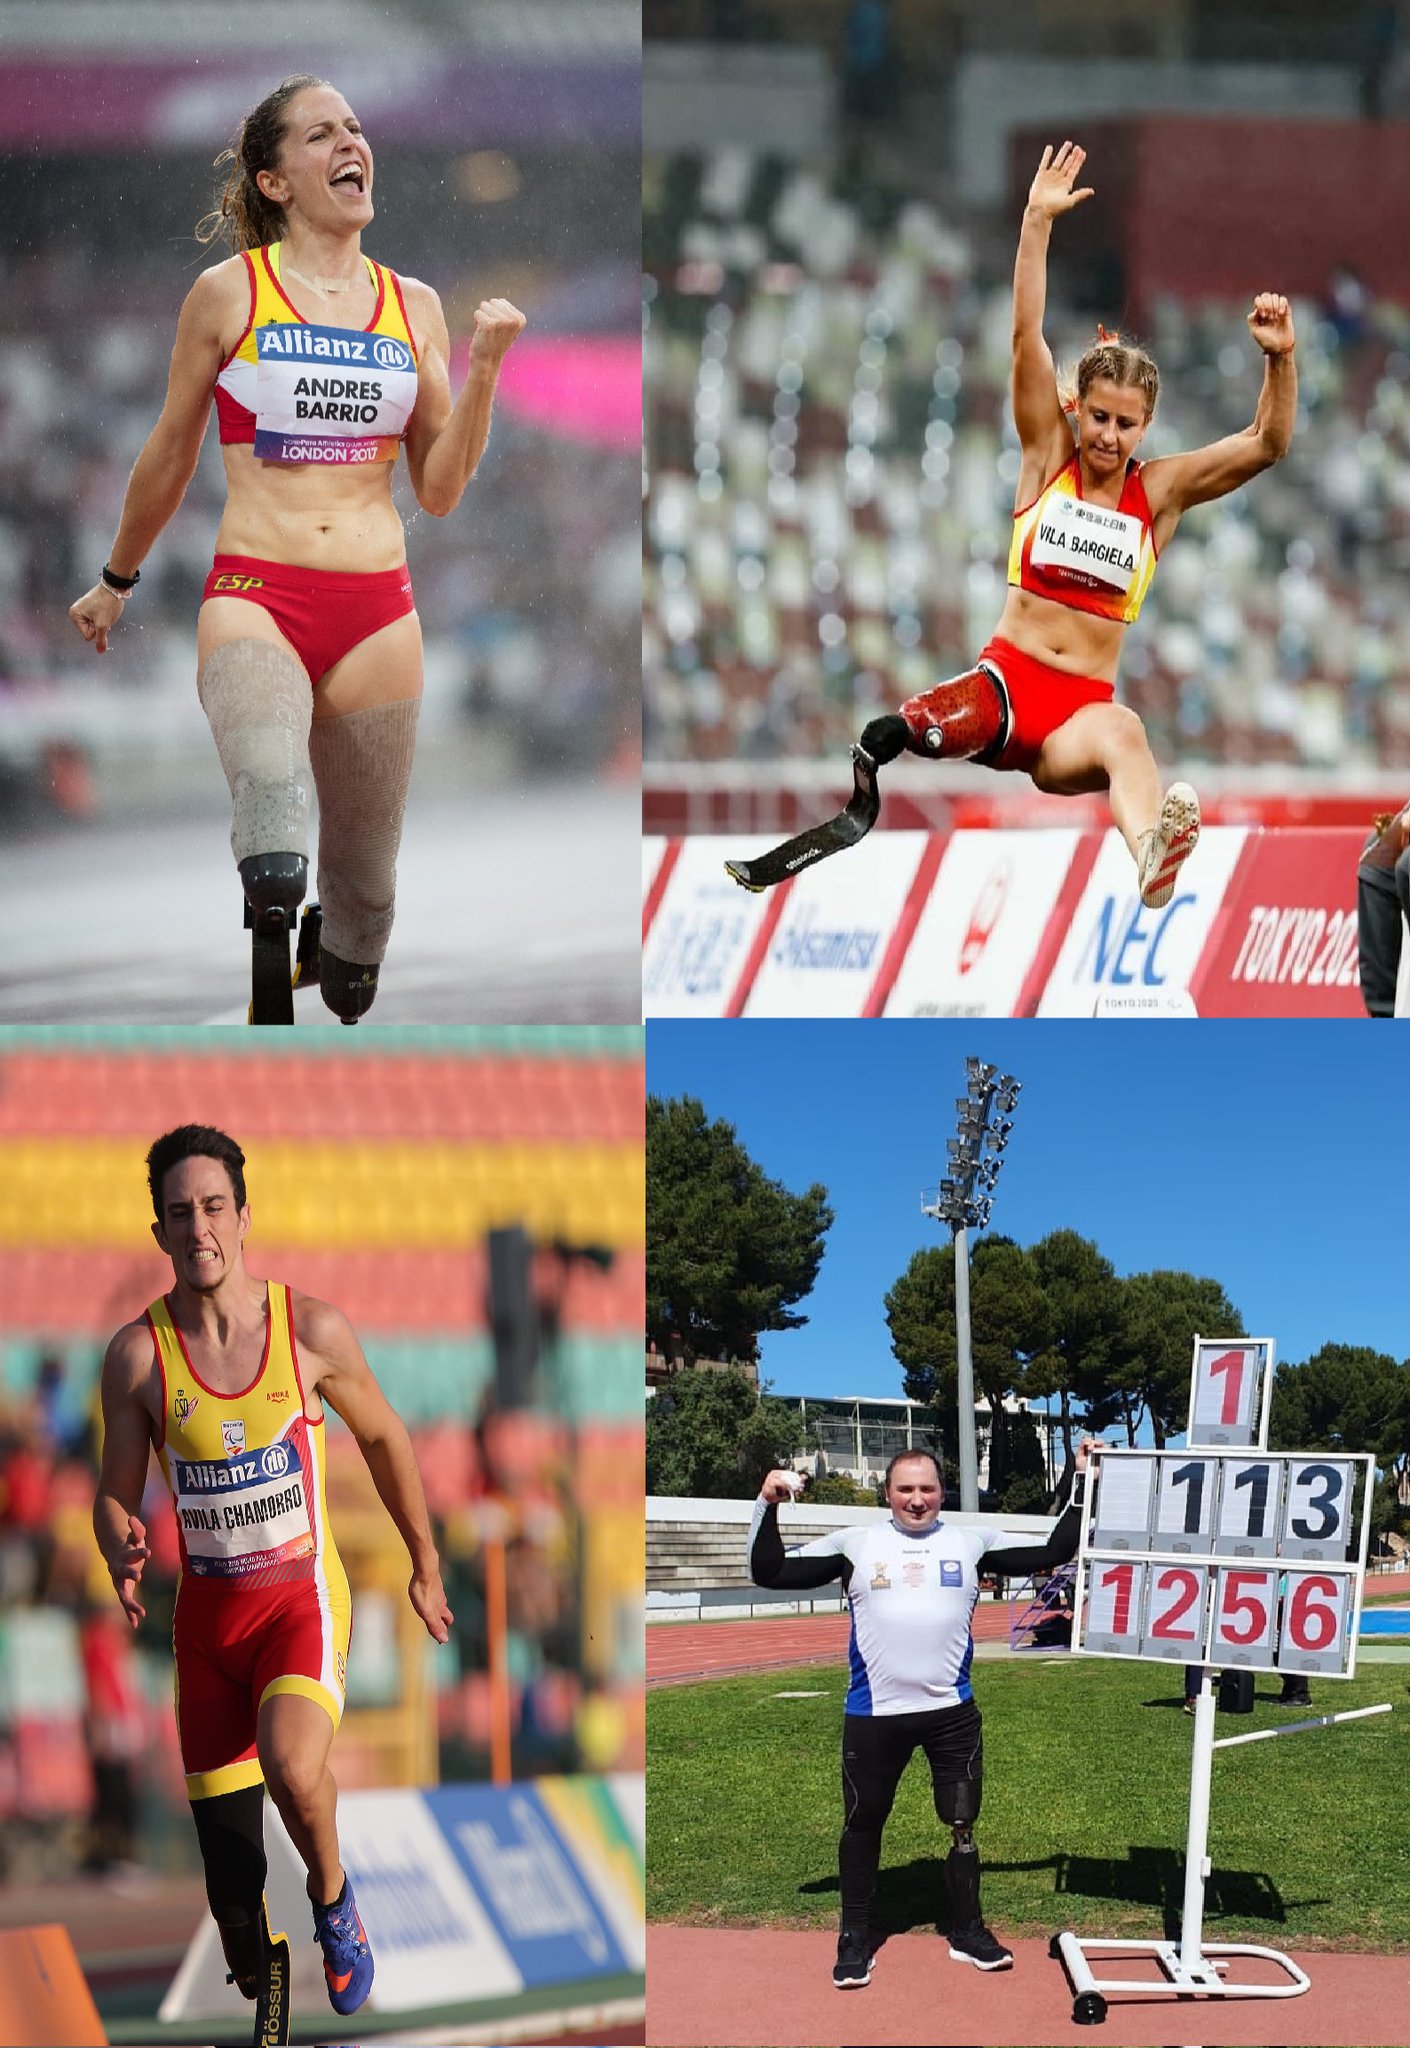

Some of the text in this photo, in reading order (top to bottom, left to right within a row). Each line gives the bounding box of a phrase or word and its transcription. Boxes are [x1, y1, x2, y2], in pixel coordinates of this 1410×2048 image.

[262, 329, 367, 361] Allianz
[294, 377, 383, 401] ANDRES
[296, 400, 378, 424] BARRIO
[282, 445, 347, 462] LONDON
[349, 447, 378, 462] 2017
[1040, 523, 1134, 571] VILA BARGIELA
[214, 575, 264, 591] ESP
[1074, 893, 1197, 986] NEC
[1230, 905, 1361, 987] TOKYO 202
[1210, 1351, 1245, 1425] 1
[175, 1398, 189, 1418] CSD
[185, 1461, 260, 1489] Allianz
[181, 1483, 303, 1531] AVILA CHAMORRO
[264, 1961, 282, 2033] ÖSSUR
